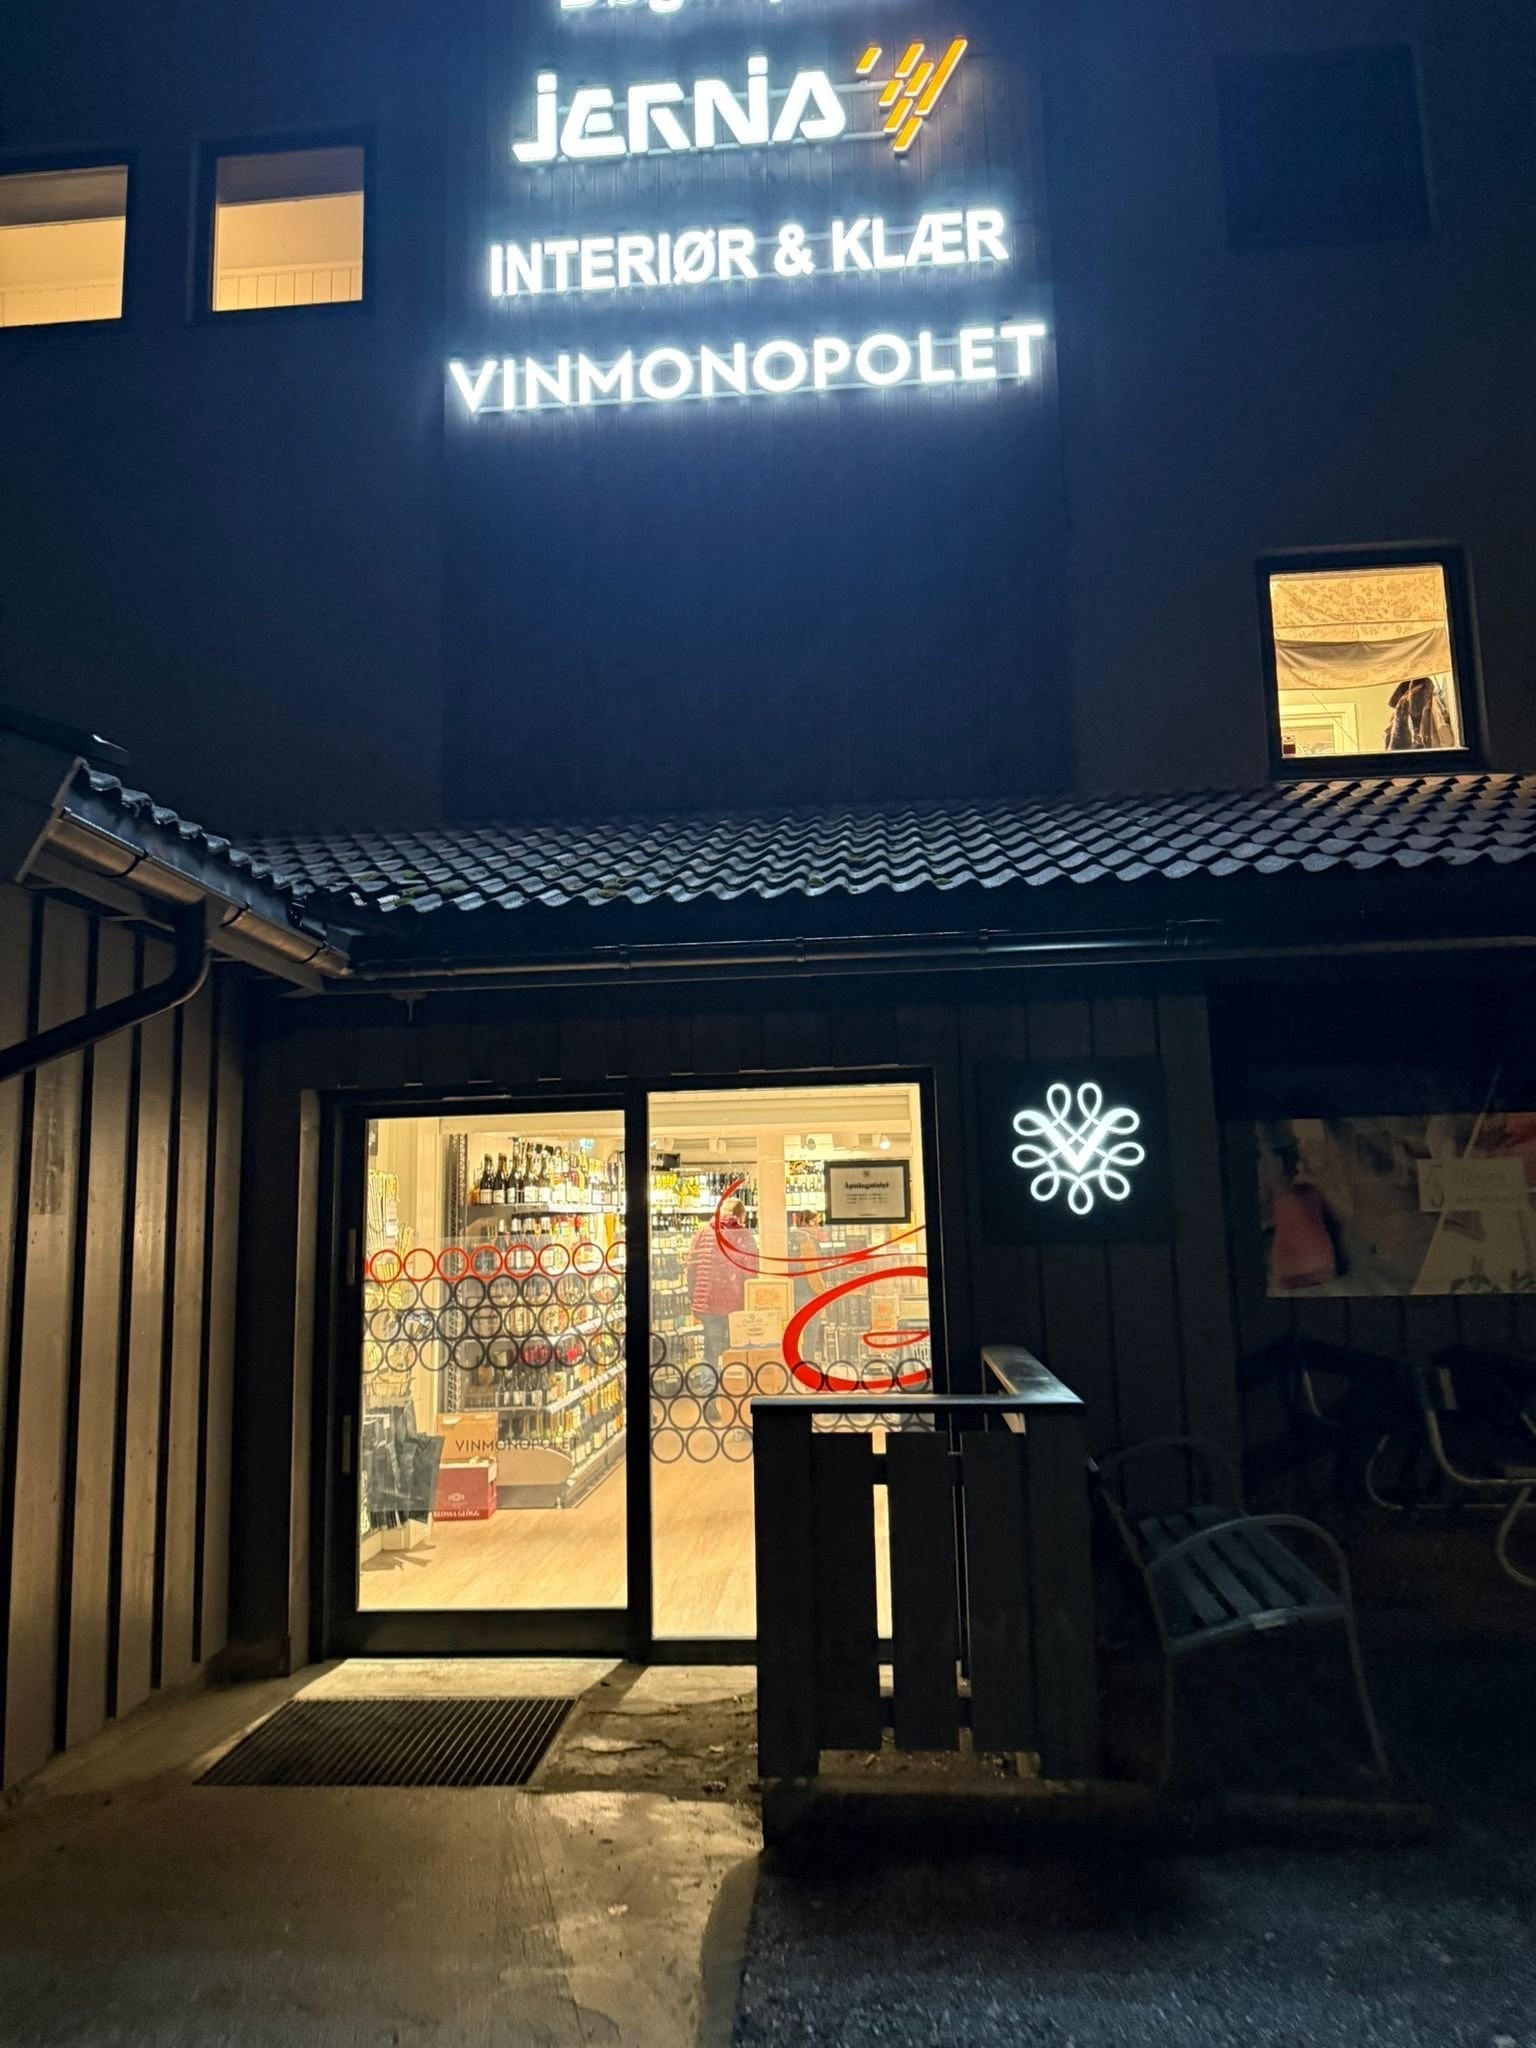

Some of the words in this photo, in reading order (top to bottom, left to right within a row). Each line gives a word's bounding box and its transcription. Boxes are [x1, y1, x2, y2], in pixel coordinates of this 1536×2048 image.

[489, 226, 759, 298] INTERIØR
[774, 223, 814, 277] &
[831, 209, 1009, 273] KLÆR
[448, 323, 1046, 413] VINMONOPOLET
[455, 1438, 580, 1451] VINMONOPOLET
